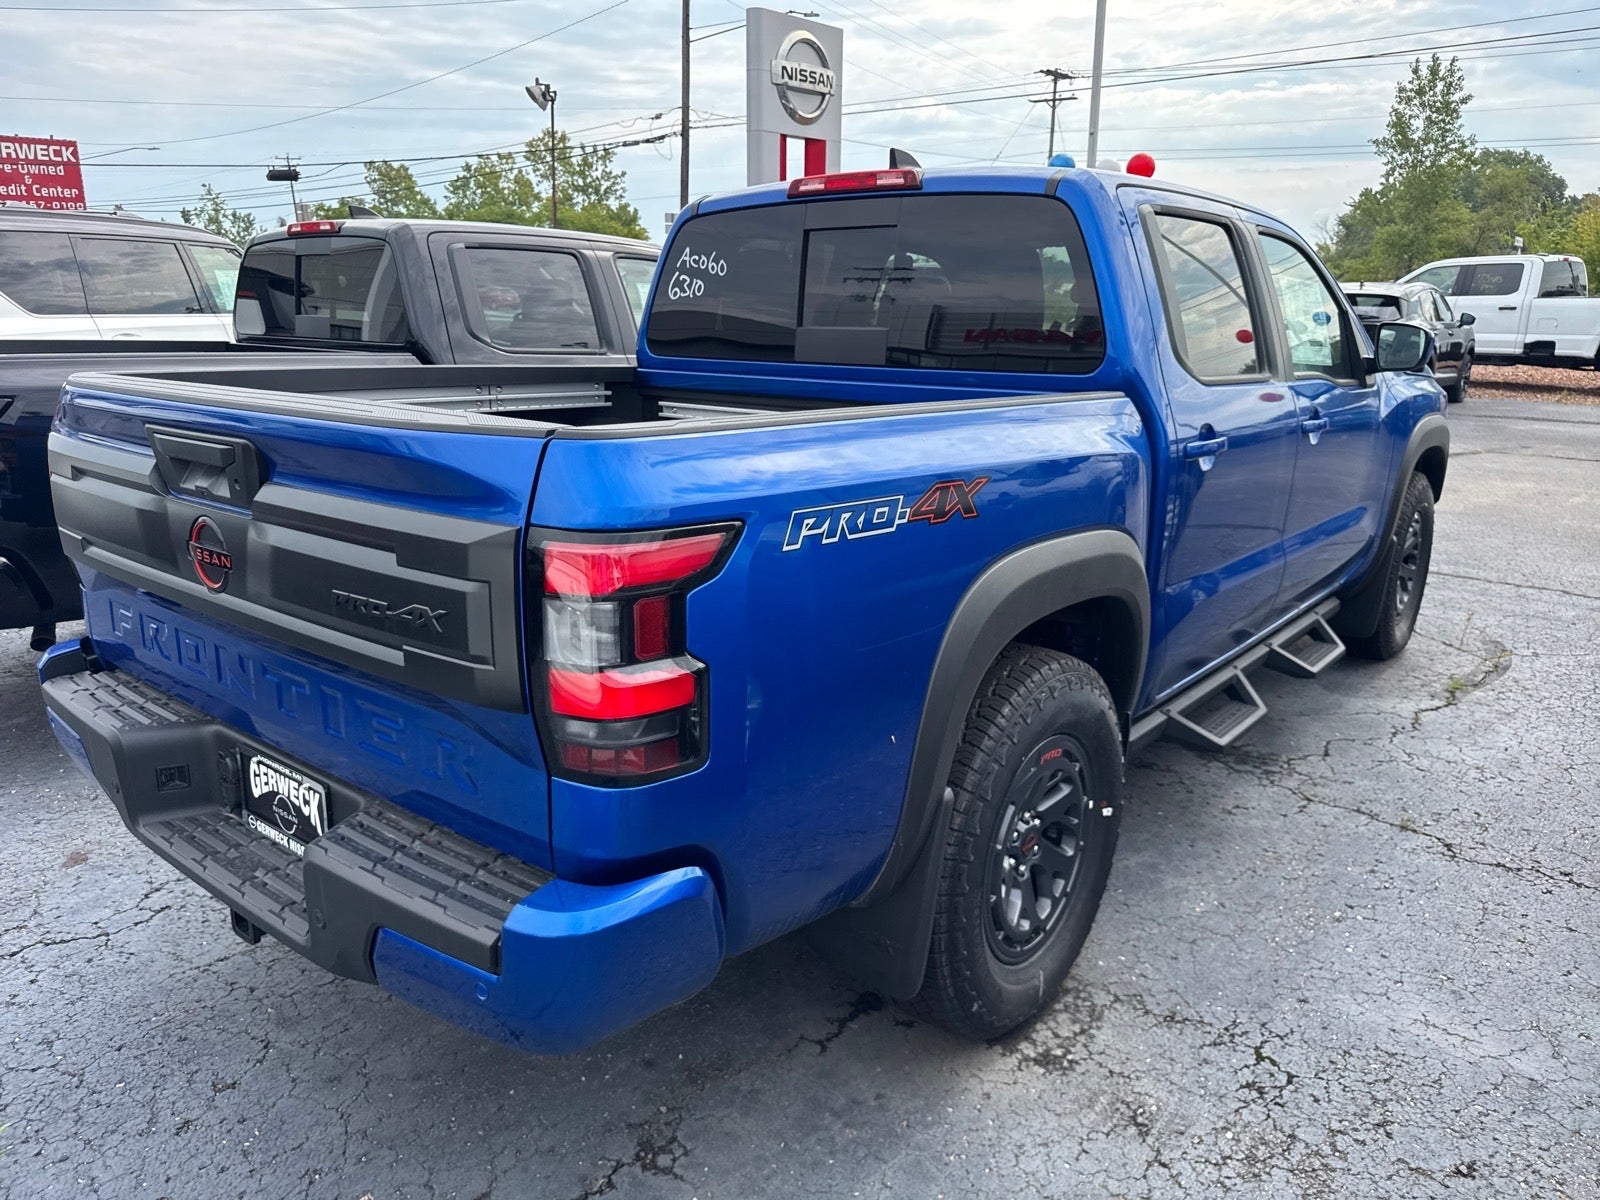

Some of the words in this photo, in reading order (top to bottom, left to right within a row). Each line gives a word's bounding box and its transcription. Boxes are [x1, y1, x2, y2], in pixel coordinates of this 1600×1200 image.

[781, 65, 833, 90] NISSAN
[0, 141, 77, 163] RWECK
[24, 175, 33, 184] &
[32, 185, 79, 198] Center
[668, 271, 705, 300] 6310
[193, 547, 232, 569] SSAN
[108, 597, 480, 796] FRONTIER
[1040, 748, 1063, 765] PRO
[250, 756, 323, 837] GERWECK
[256, 820, 289, 849] GERWECK
